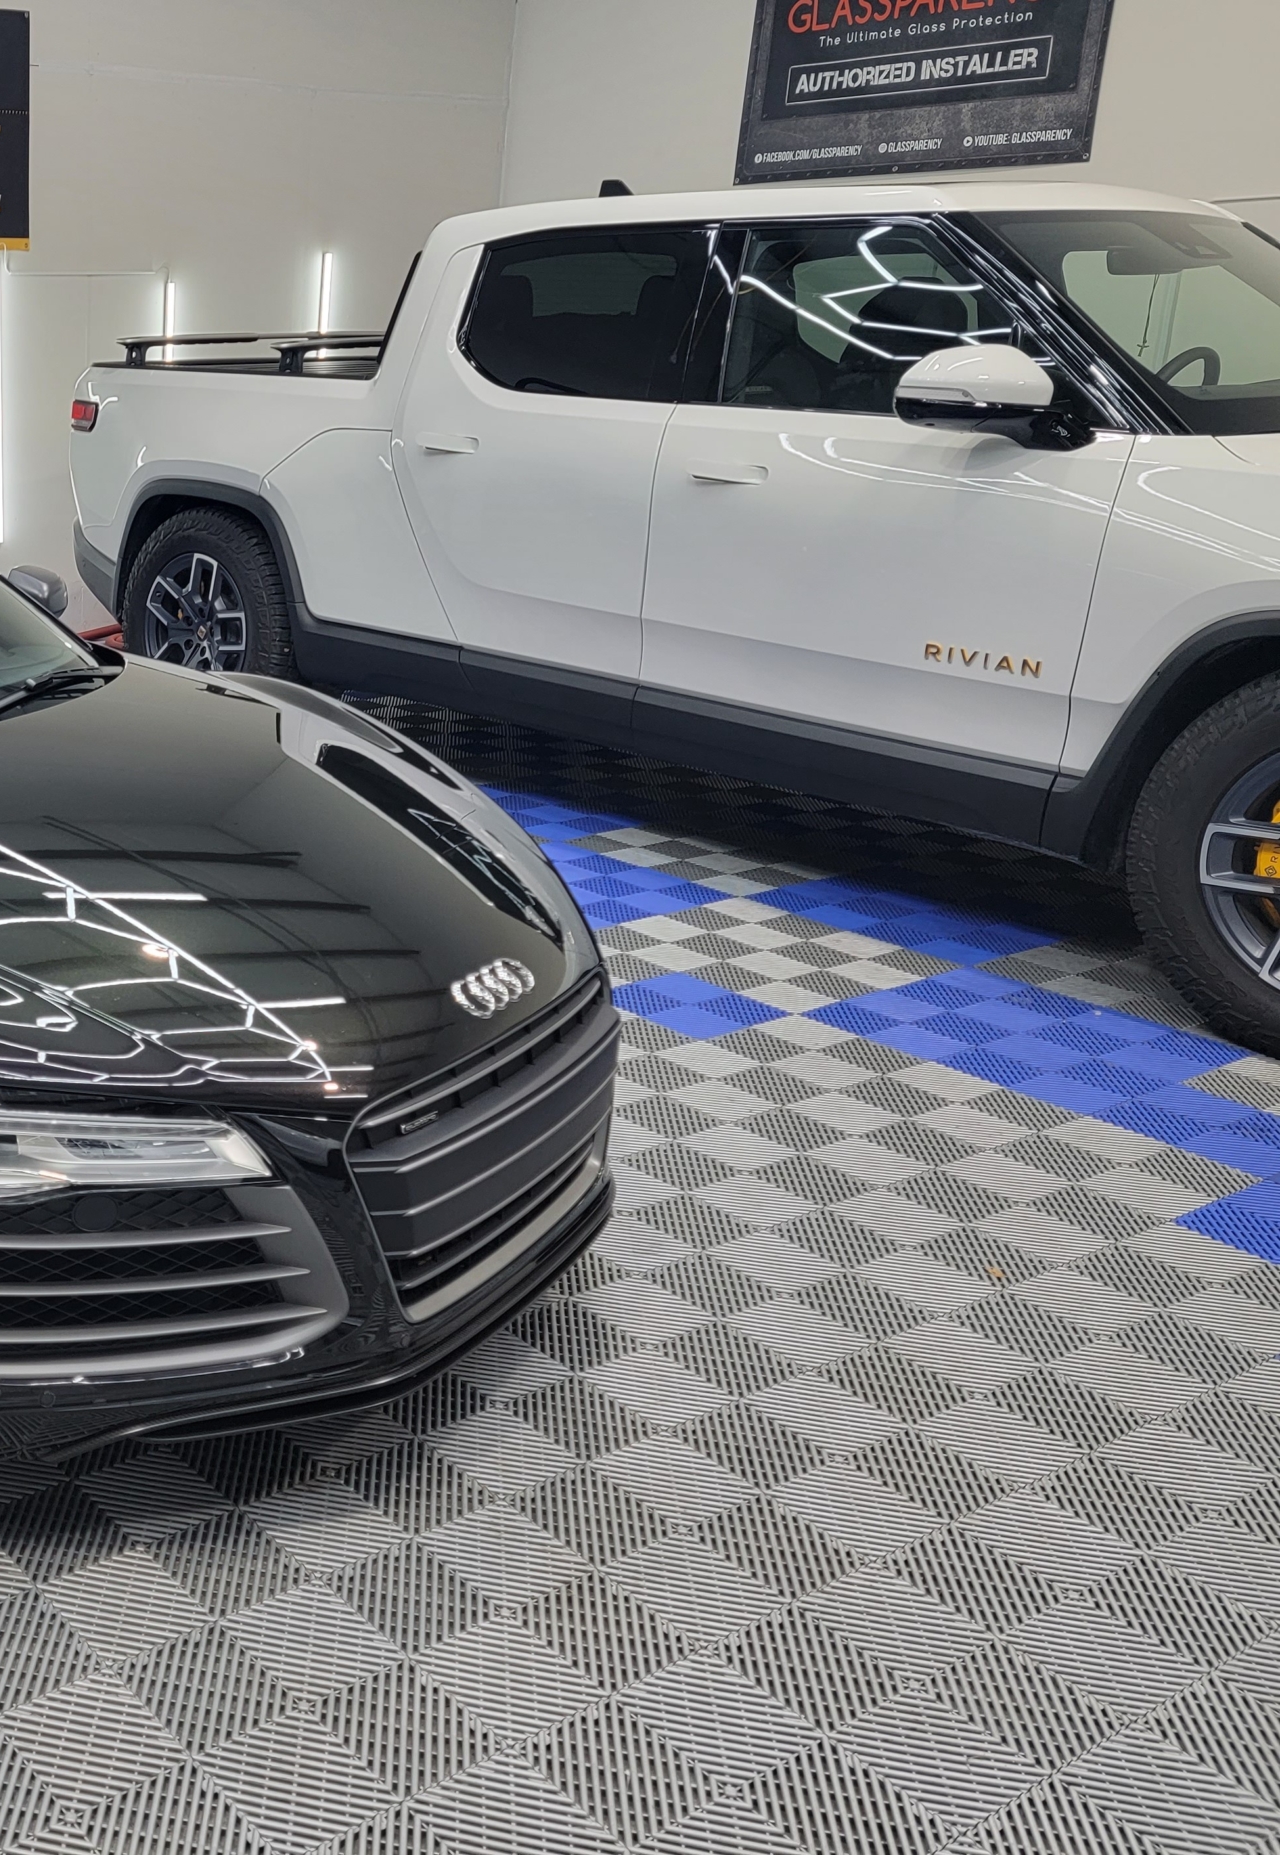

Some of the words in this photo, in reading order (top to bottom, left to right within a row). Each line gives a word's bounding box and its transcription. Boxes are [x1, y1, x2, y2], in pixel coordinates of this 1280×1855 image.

[819, 35, 841, 48] The
[846, 28, 902, 45] Ultimate
[907, 22, 946, 36] Glass
[952, 11, 1034, 30] Protection
[795, 61, 916, 95] AUTHORIZED
[920, 47, 1039, 81] INSTALLER
[887, 138, 943, 153] GLASSPARENCY
[974, 133, 1010, 147] YOUTUBE:
[1011, 128, 1073, 144] GLASSPARENCY
[762, 145, 863, 163] FACEBOOK.COM/GLASSPARENCY
[924, 642, 1043, 679] RIVIAN
